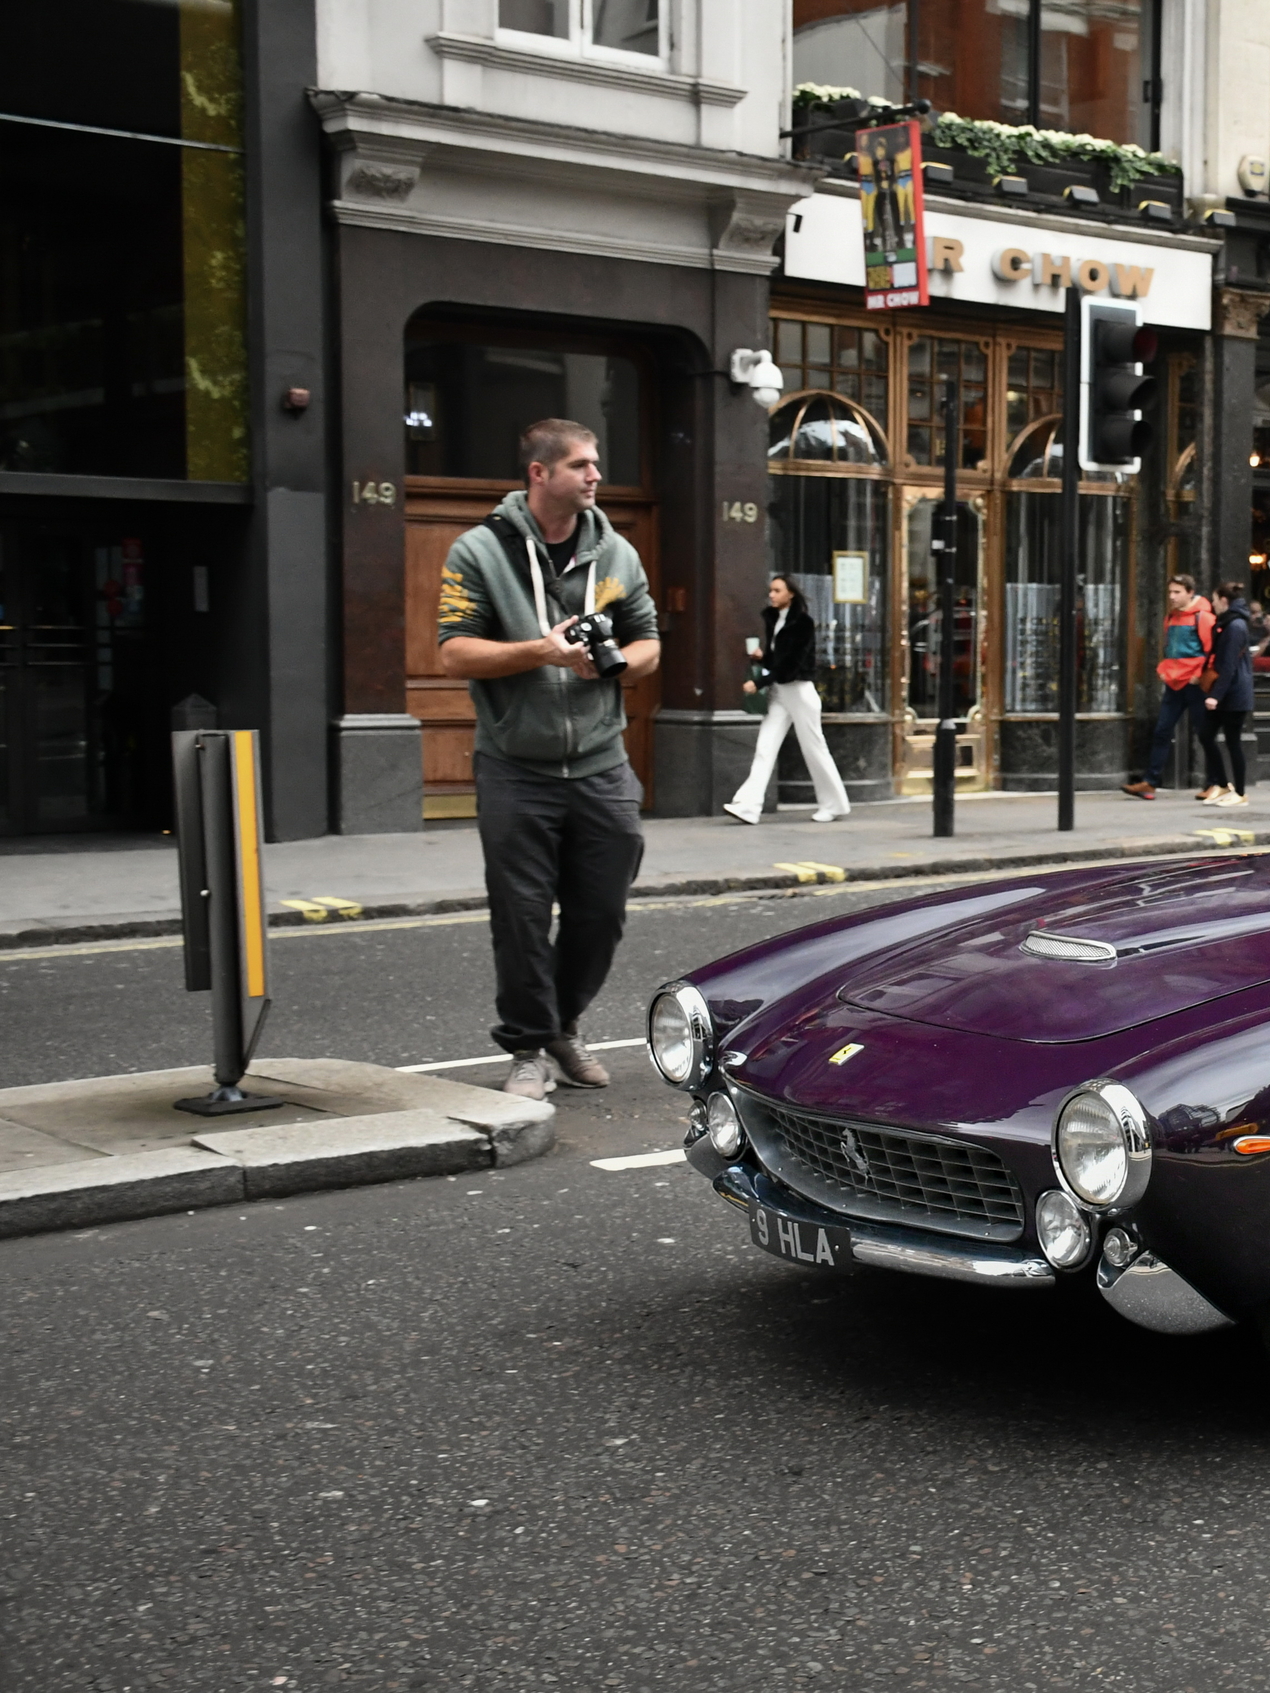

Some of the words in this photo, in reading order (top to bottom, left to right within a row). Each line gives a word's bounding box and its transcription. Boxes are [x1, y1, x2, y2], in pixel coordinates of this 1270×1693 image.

[992, 248, 1155, 297] CHOW
[867, 295, 885, 309] MR
[887, 291, 919, 308] CHOW
[353, 481, 396, 505] 149
[723, 501, 758, 523] 149
[757, 1209, 769, 1245] 9
[777, 1218, 835, 1266] HLA
